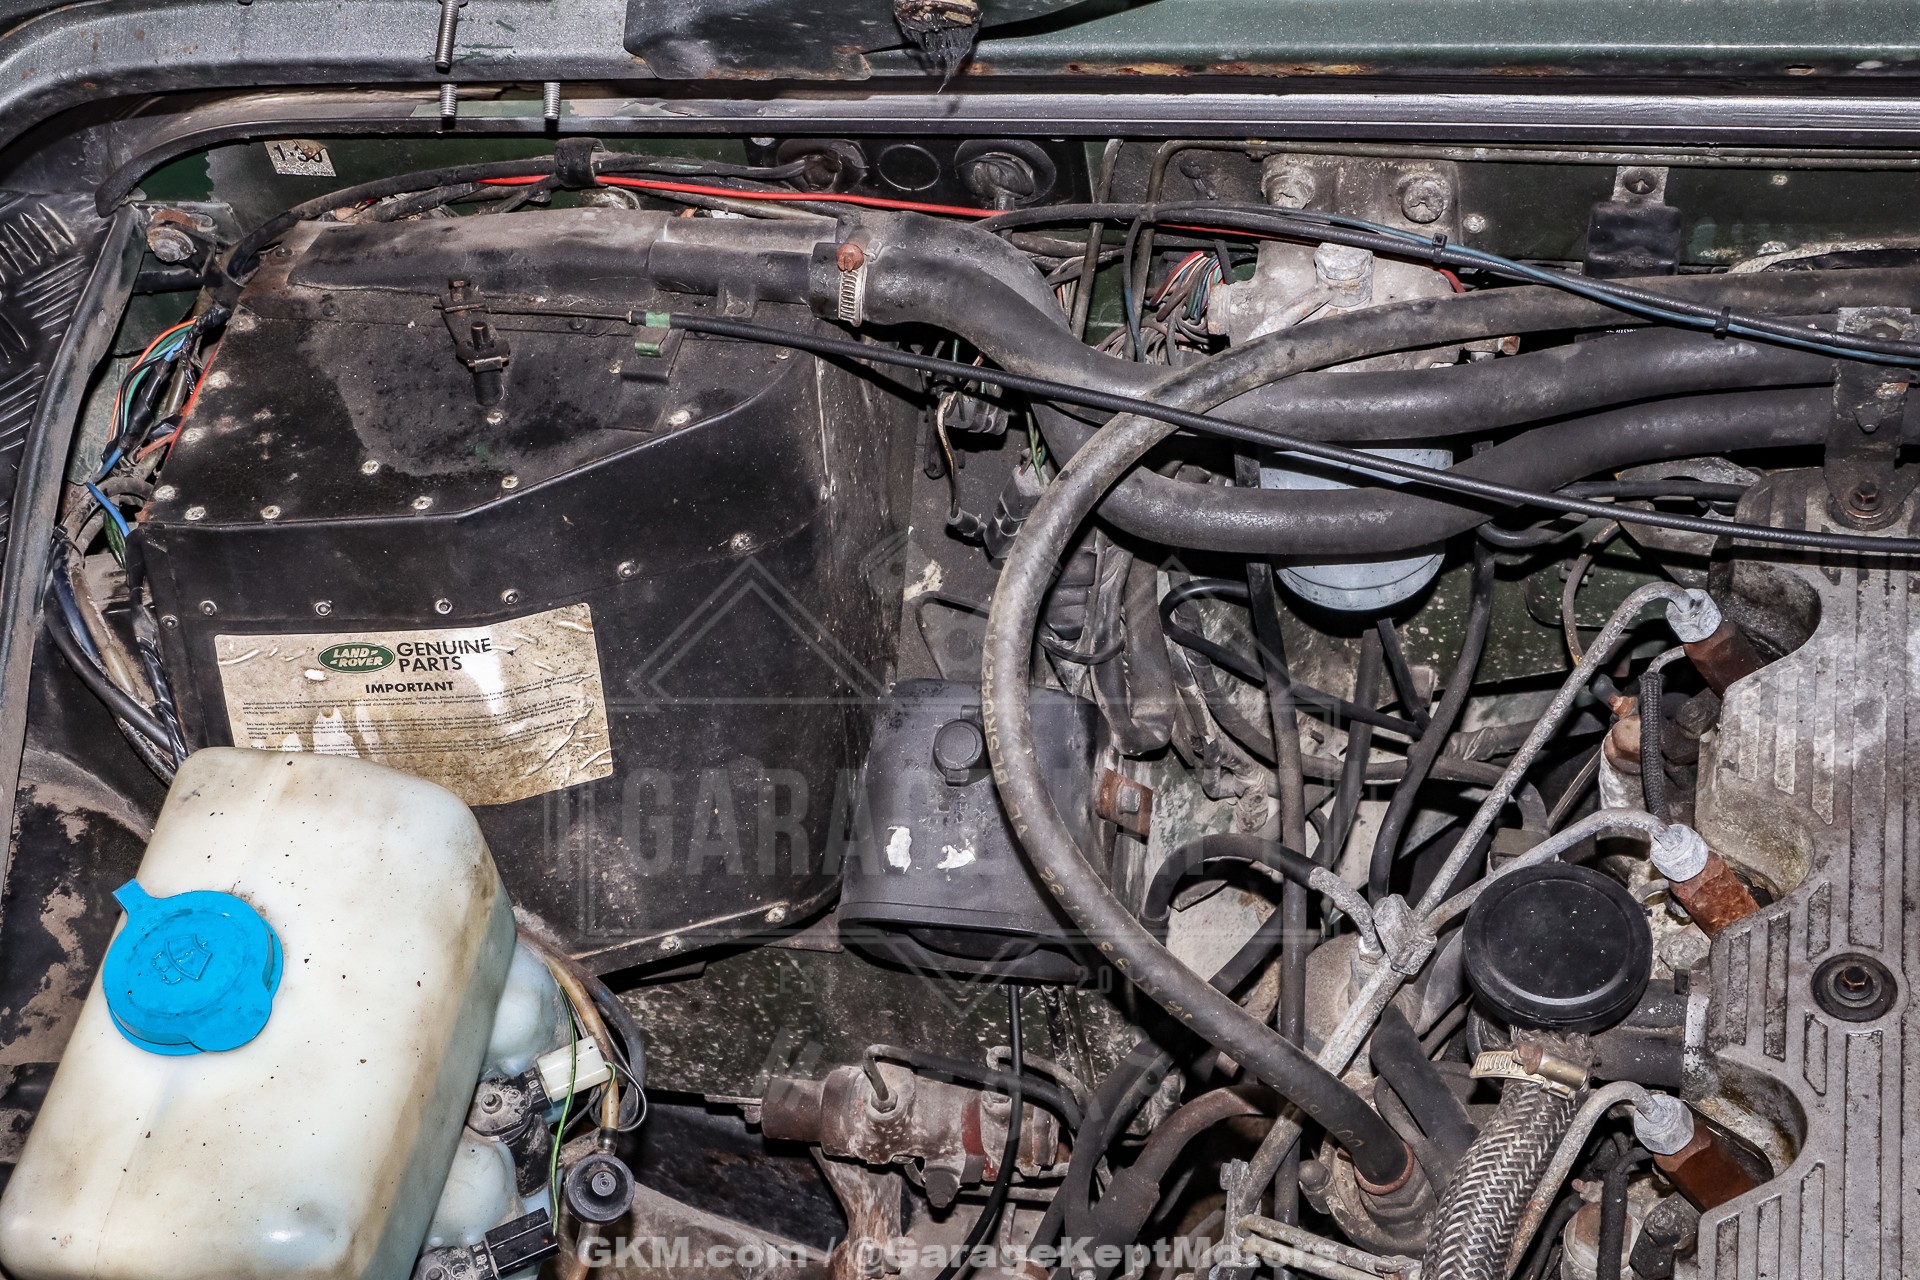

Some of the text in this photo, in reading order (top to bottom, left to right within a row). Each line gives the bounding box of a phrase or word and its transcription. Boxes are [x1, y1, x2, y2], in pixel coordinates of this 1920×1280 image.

[332, 647, 368, 659] LAND
[397, 638, 492, 656] GENUINE
[338, 656, 383, 668] ROVER
[399, 656, 463, 672] PARTS
[365, 681, 454, 693] IMPORTANT
